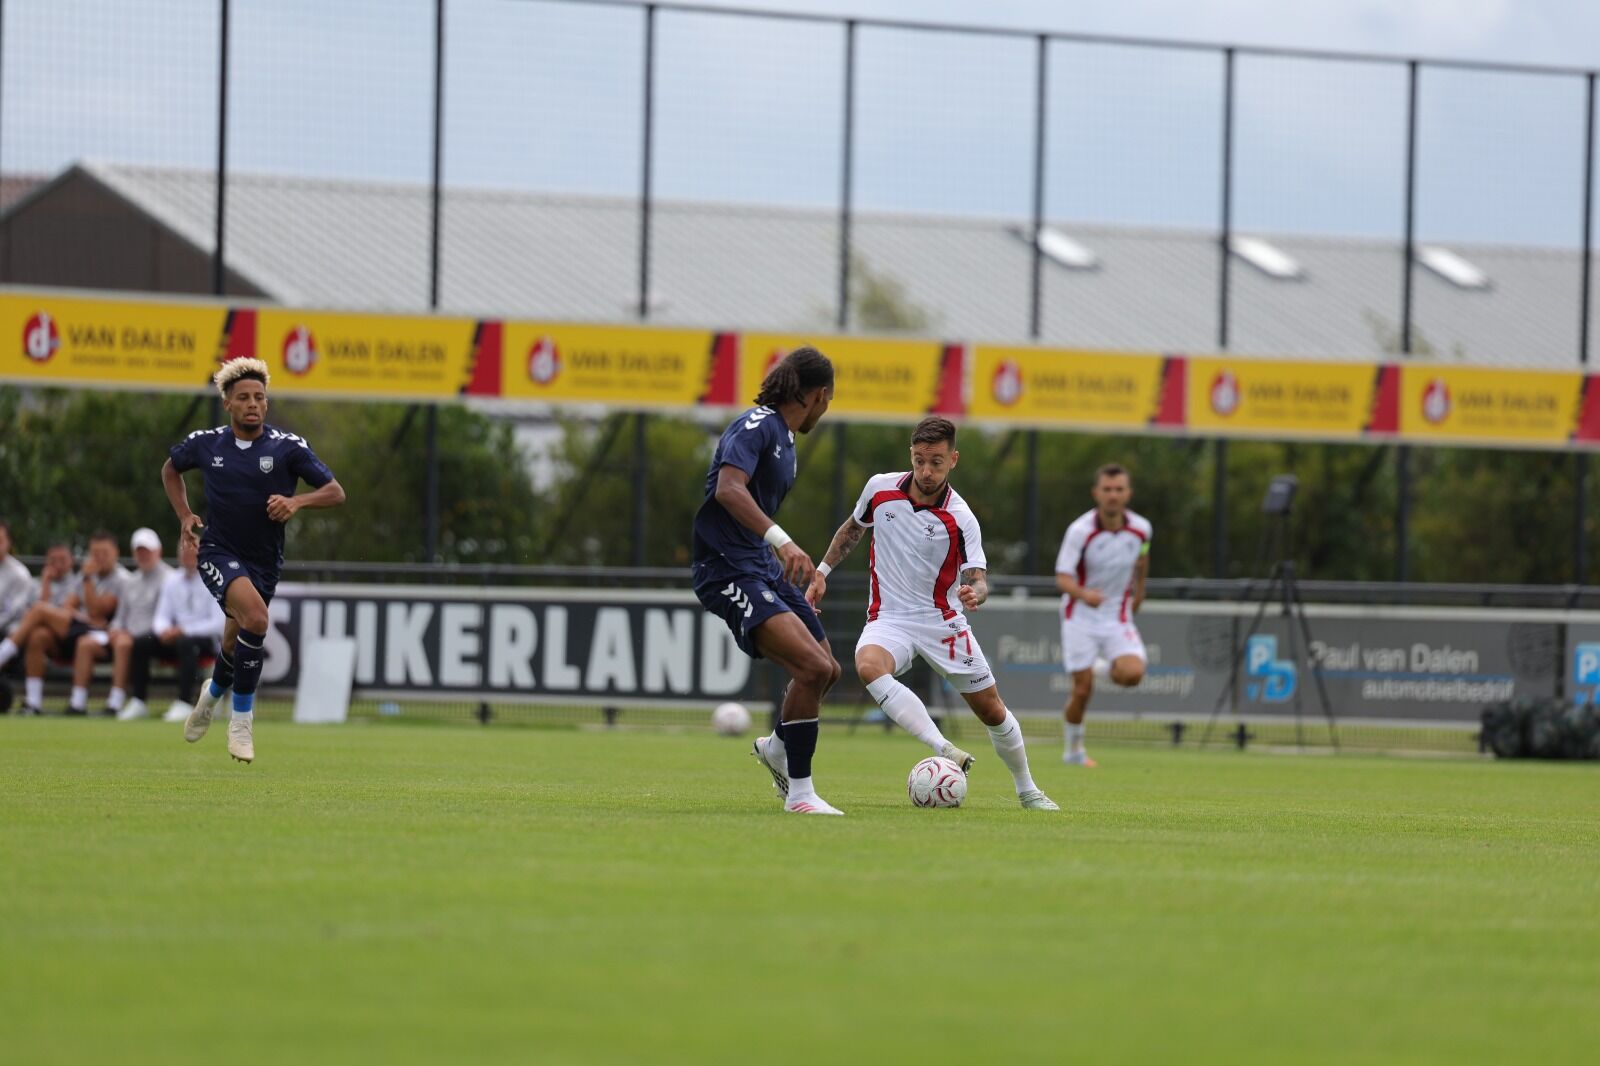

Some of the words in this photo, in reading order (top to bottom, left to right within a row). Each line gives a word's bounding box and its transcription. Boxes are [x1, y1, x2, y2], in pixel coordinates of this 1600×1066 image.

[68, 325, 115, 348] VAN
[122, 328, 196, 352] DALEN
[326, 337, 370, 359] VAN
[378, 340, 447, 364] DALEN
[941, 630, 972, 661] 77
[1362, 647, 1407, 671] van
[1411, 641, 1479, 673] Dalen
